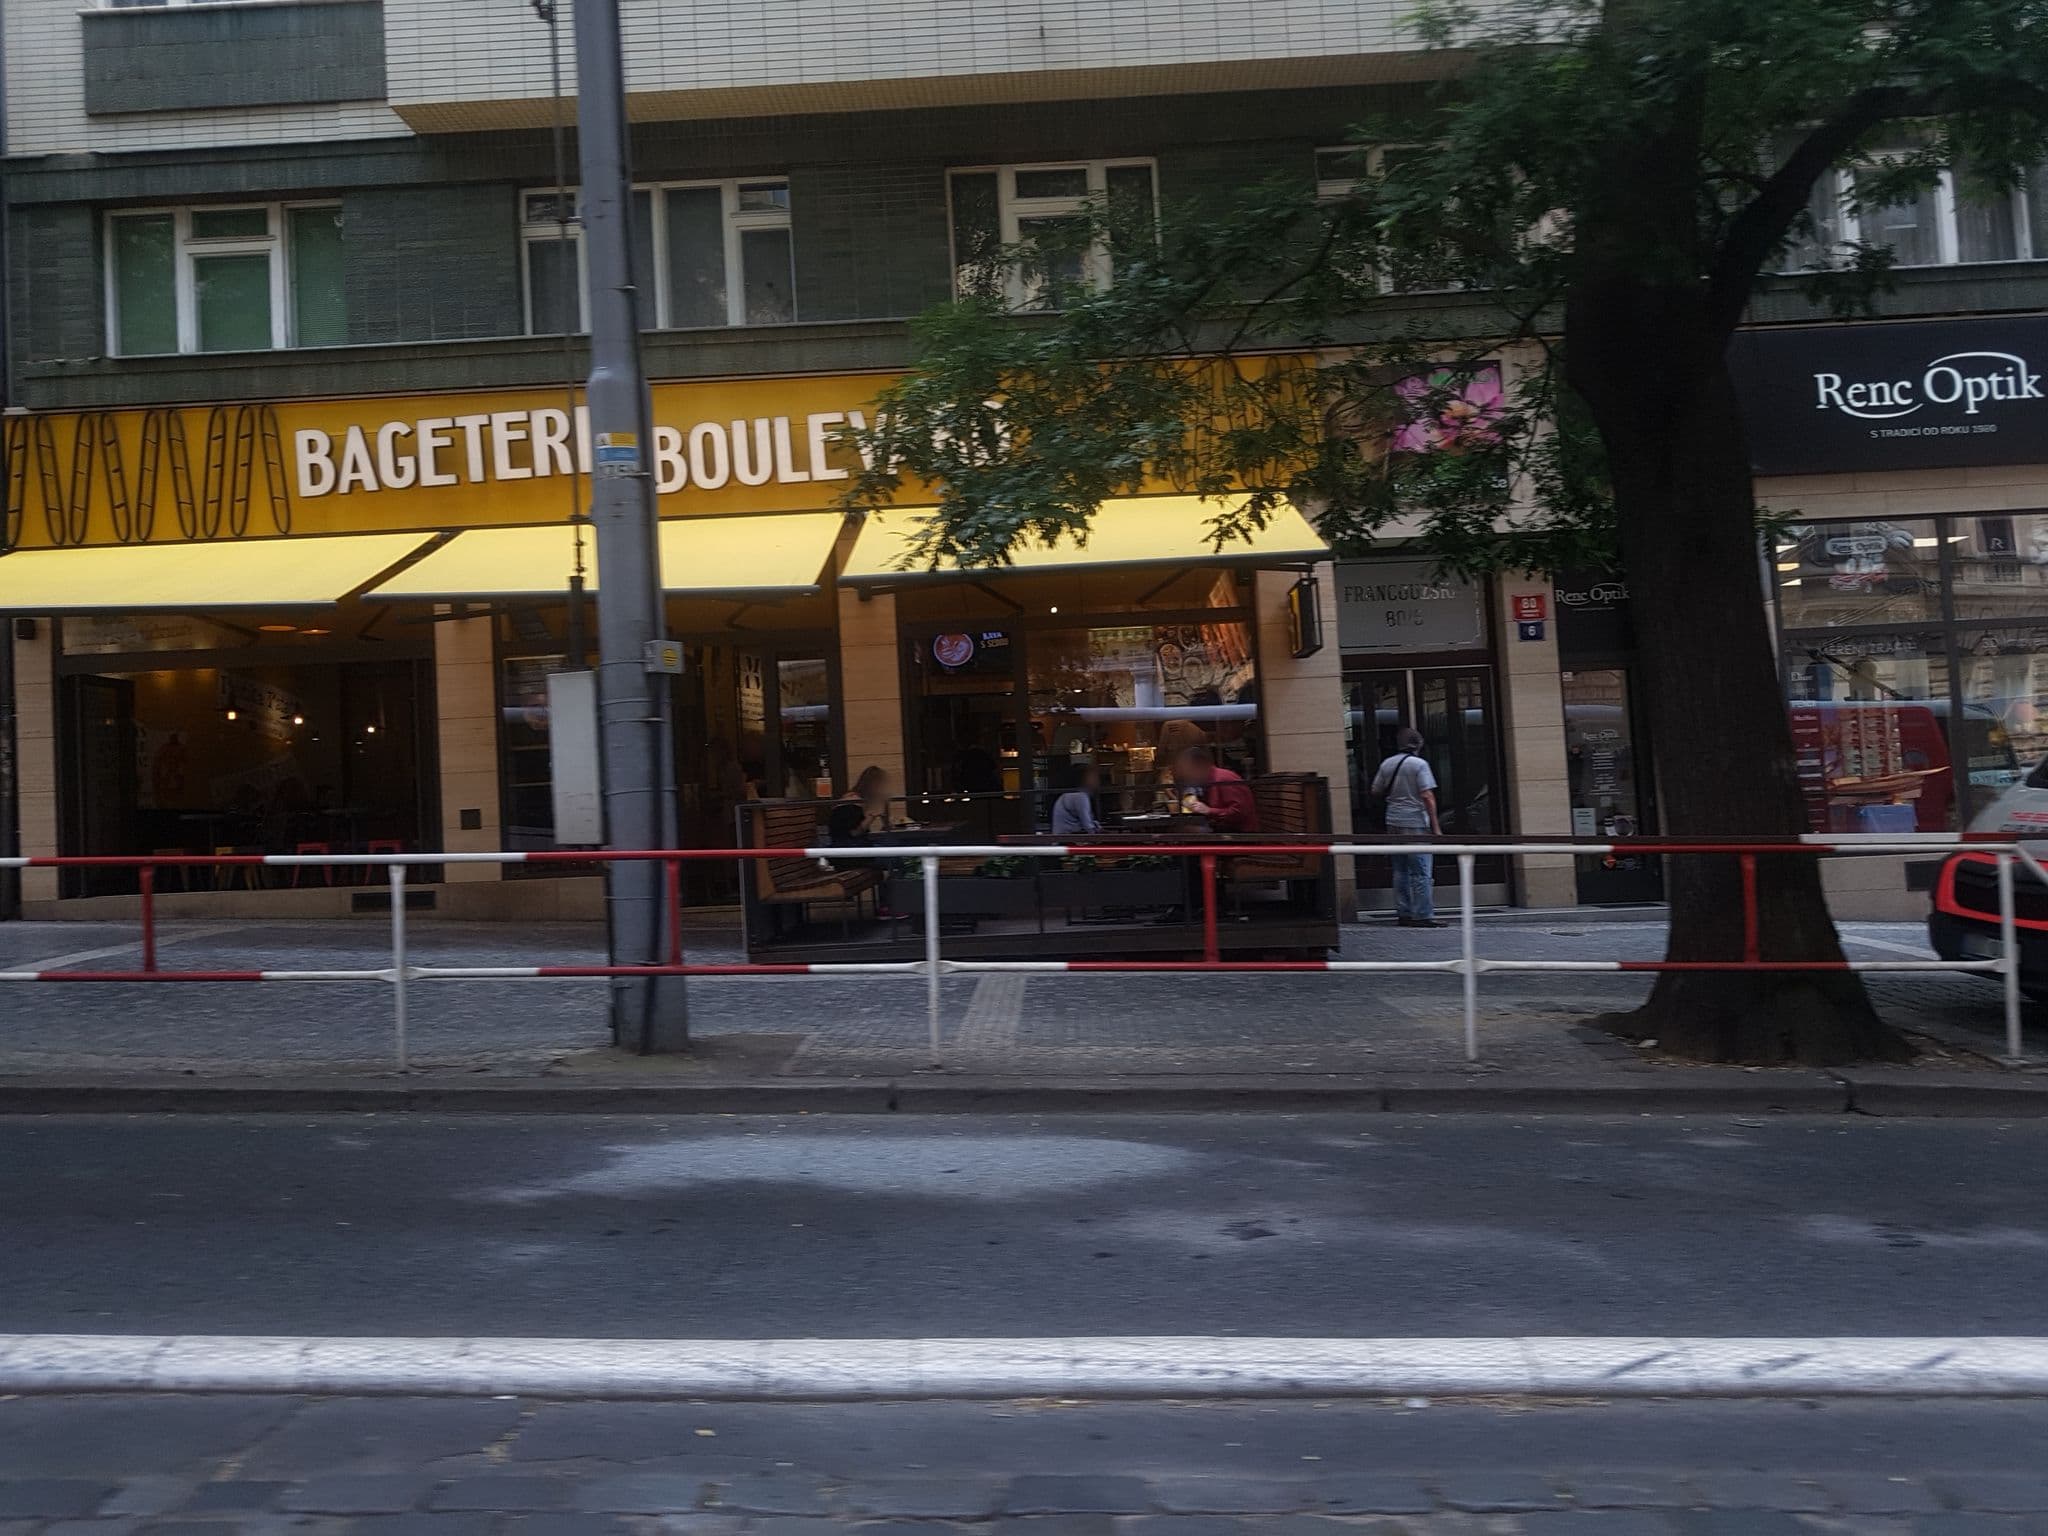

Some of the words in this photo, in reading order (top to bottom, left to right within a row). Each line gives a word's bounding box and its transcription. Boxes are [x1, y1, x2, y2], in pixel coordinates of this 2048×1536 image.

[1813, 372, 1923, 419] Renc
[1923, 351, 2045, 414] Optik
[1869, 430, 1879, 439] S
[1922, 427, 1940, 436] OD
[1941, 425, 1970, 435] ROKU
[295, 407, 593, 498] BAGETERI
[1555, 590, 1590, 605] Renc
[1590, 582, 1630, 605] Optik
[1527, 625, 1537, 637] 6
